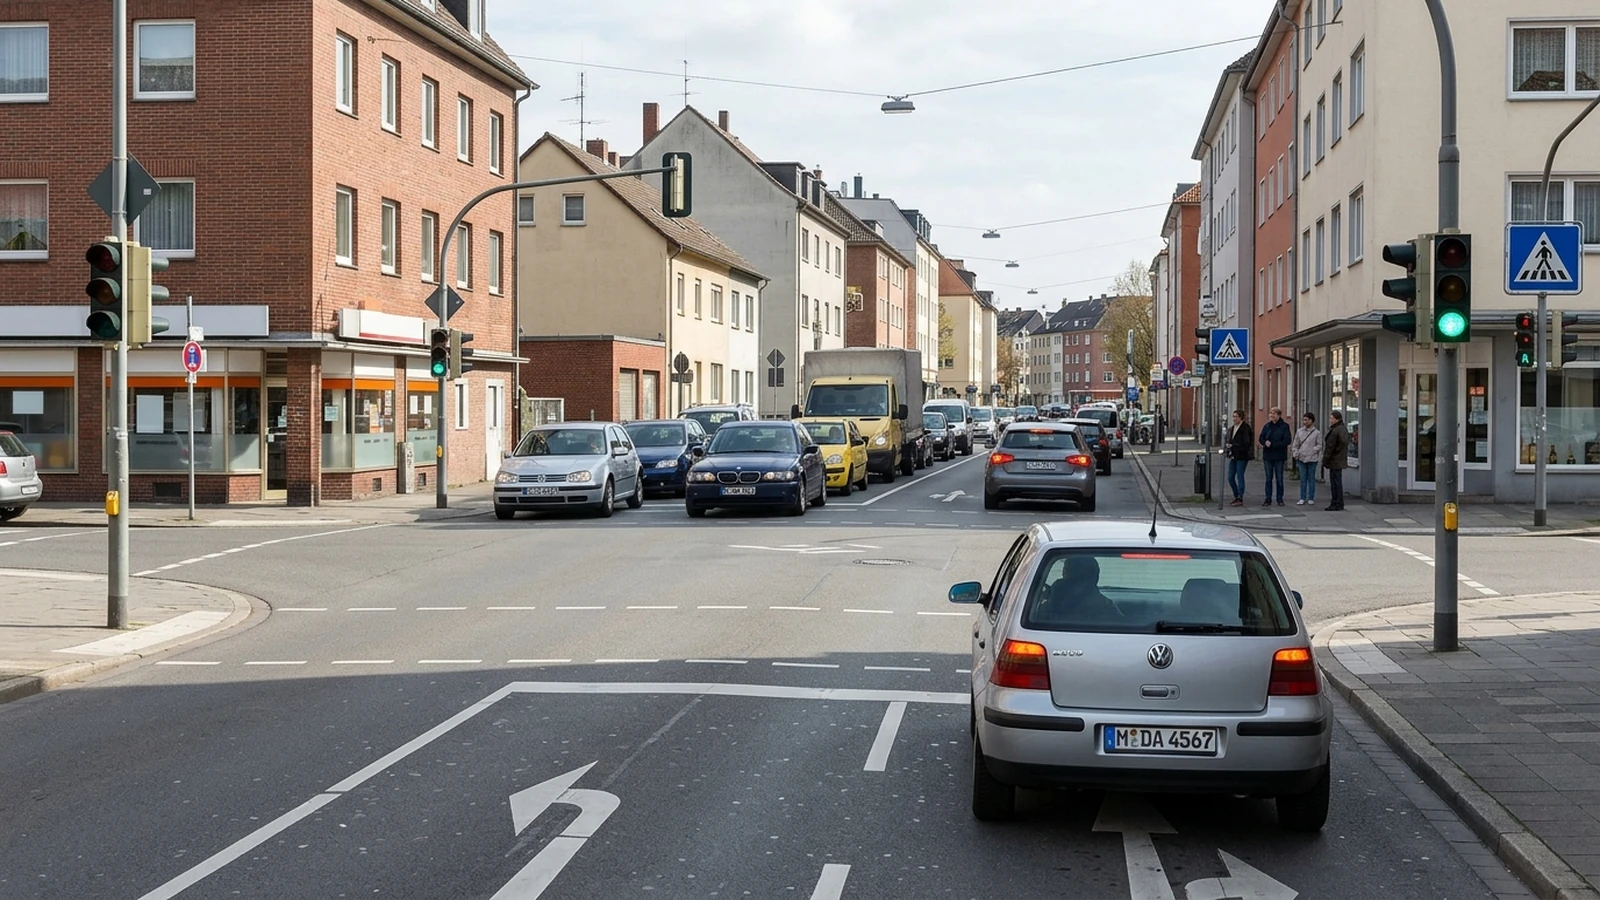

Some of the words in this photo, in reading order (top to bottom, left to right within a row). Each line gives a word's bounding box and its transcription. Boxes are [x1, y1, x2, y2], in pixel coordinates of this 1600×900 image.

[1116, 729, 1129, 747] M
[1140, 729, 1164, 748] DA
[1168, 730, 1214, 749] 4567
